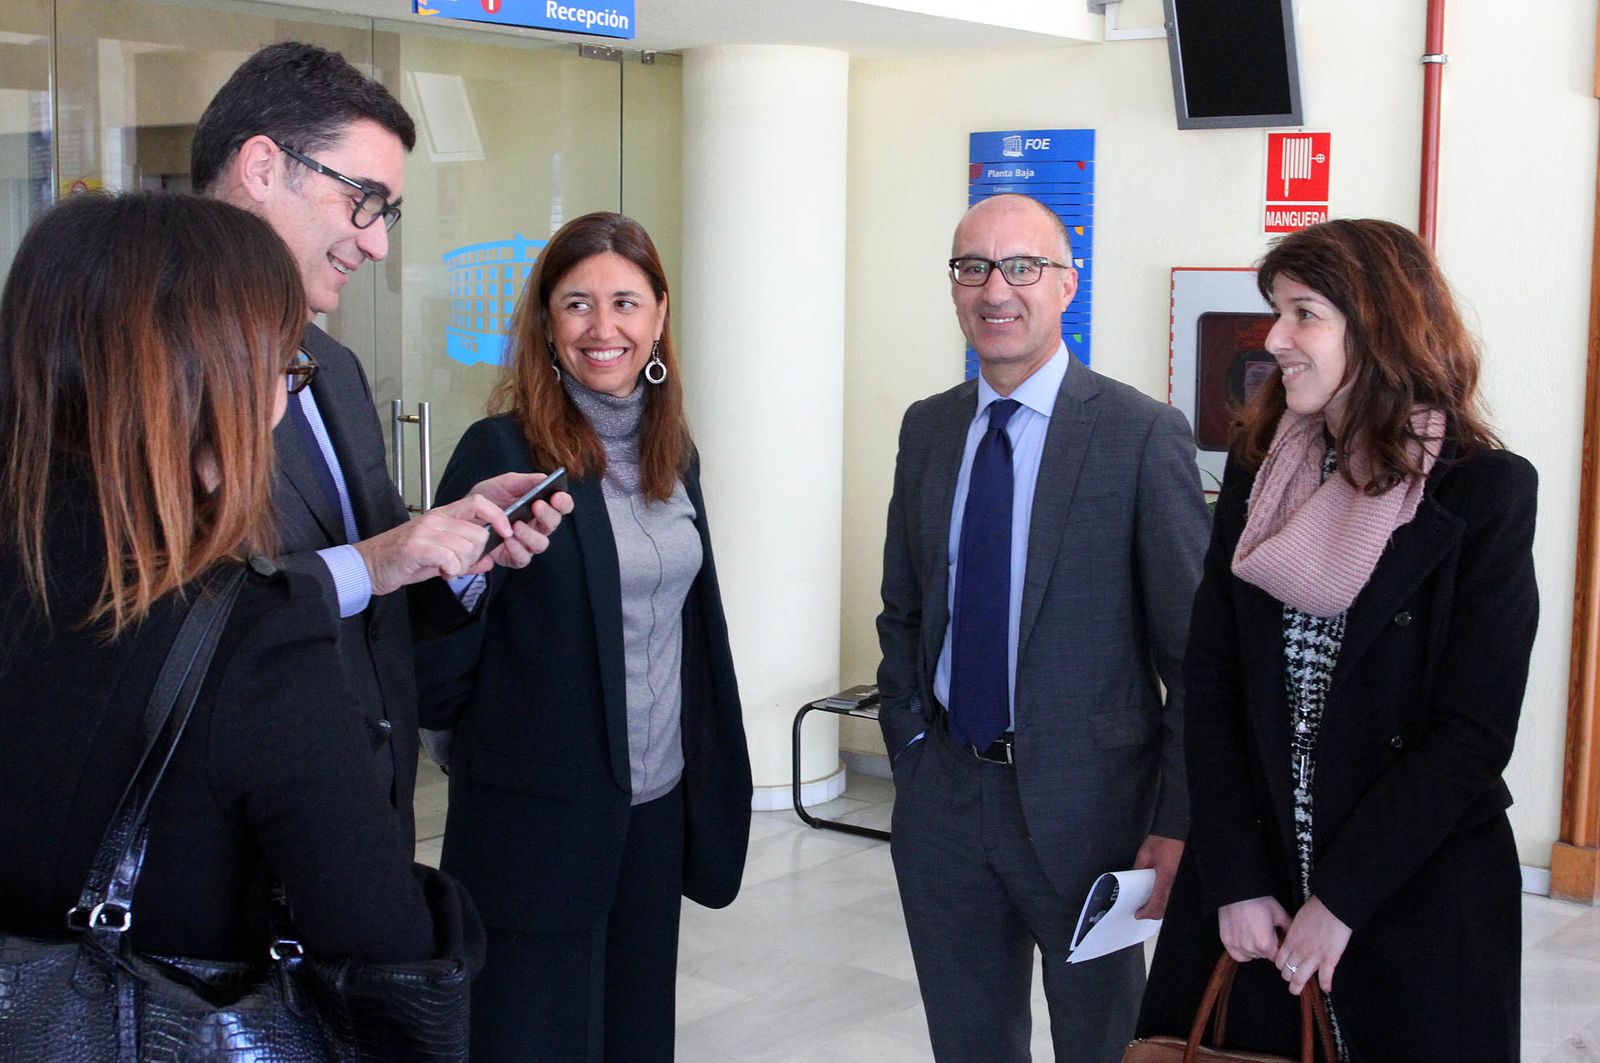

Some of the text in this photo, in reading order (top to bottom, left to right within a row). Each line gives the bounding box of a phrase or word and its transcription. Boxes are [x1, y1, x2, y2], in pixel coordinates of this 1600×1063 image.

[545, 0, 629, 30] Recepción
[1025, 138, 1051, 150] FOE
[987, 168, 1035, 179] Planta Baja
[1265, 211, 1327, 227] MANGUERA
